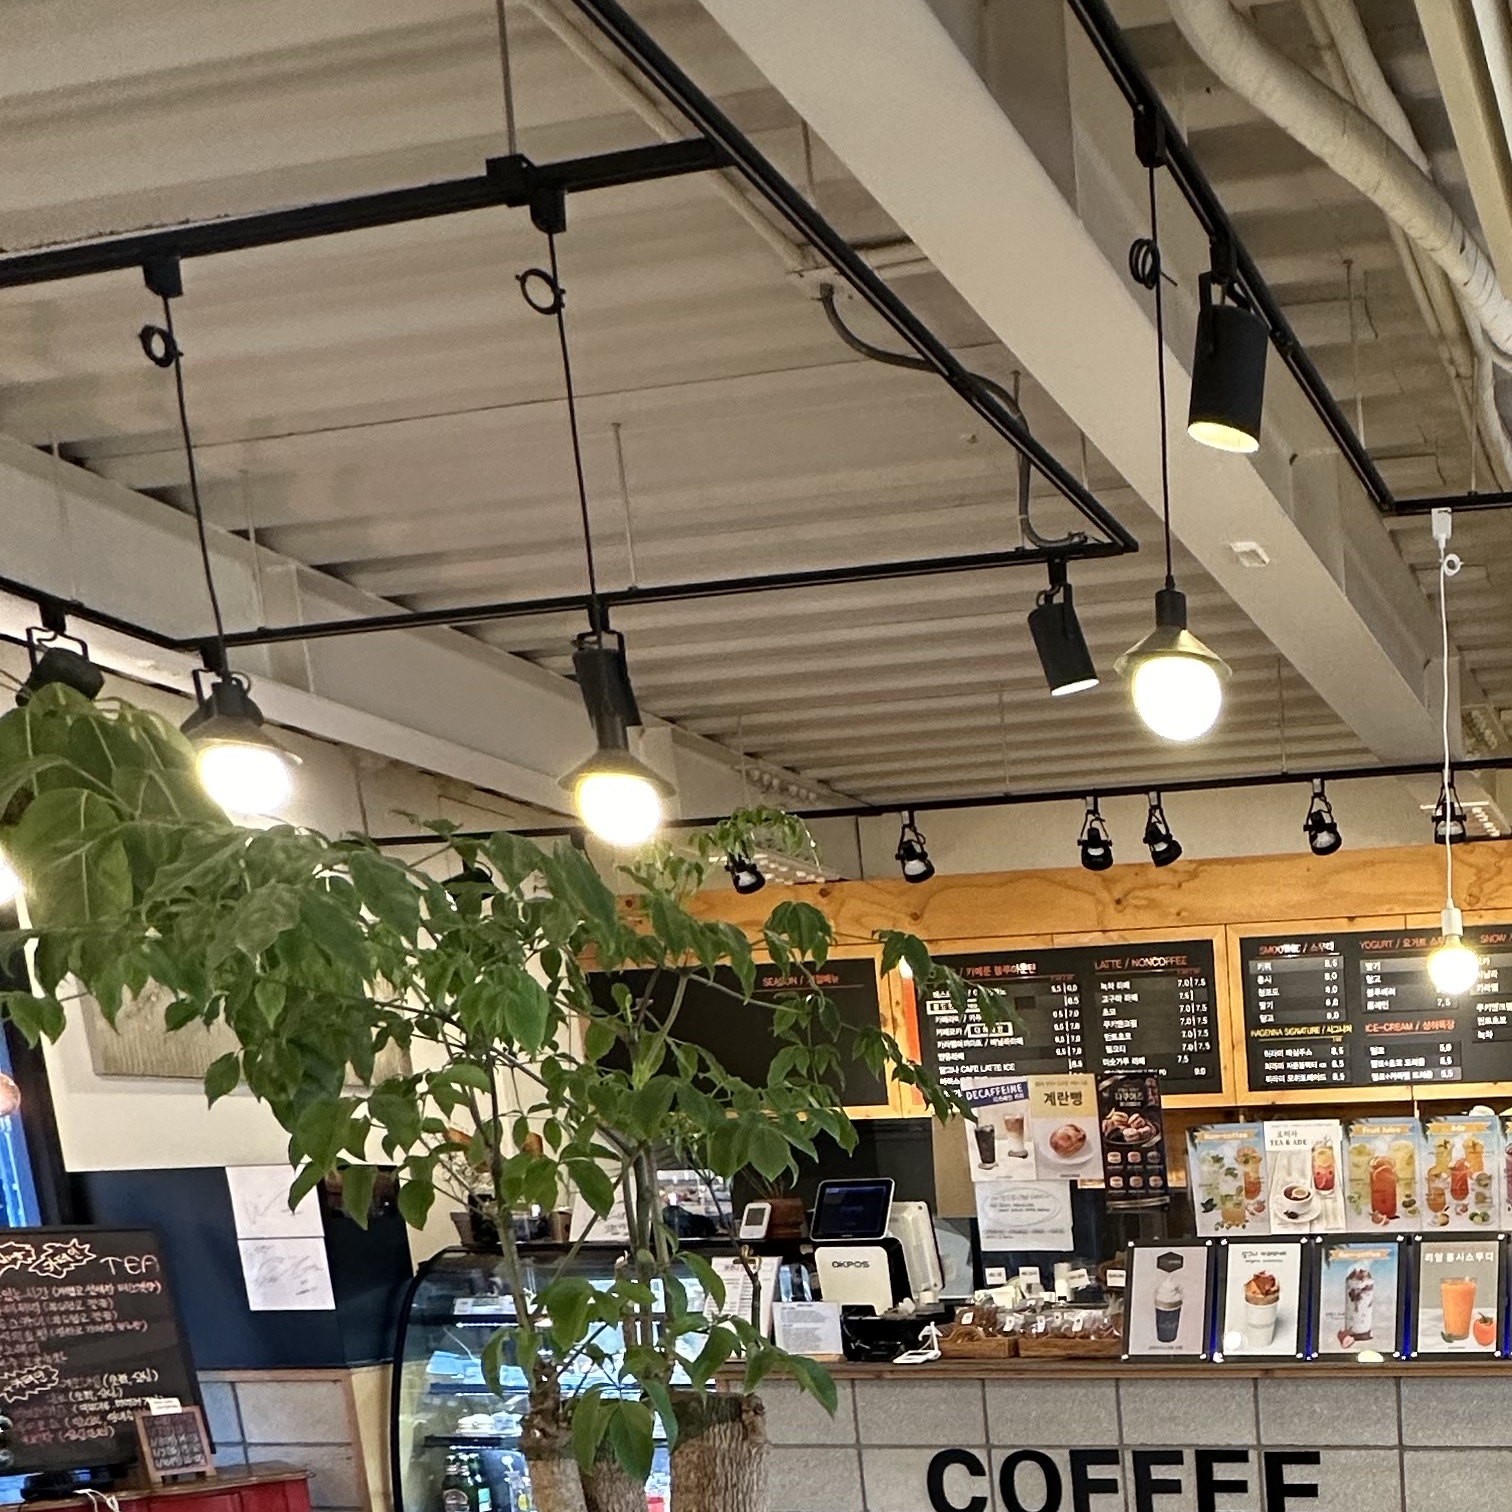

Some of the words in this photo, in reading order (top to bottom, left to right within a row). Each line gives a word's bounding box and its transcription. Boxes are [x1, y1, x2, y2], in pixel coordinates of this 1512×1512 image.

[1360, 940, 1393, 950] YOGURT
[1094, 959, 1122, 969] LATTE
[1365, 1023, 1413, 1032] ICE-CREAM
[966, 1084, 1023, 1100] DECAFFEINE
[1044, 1091, 1082, 1106] 계란빵
[100, 1255, 159, 1275] TEA
[831, 1260, 870, 1269] OKPOS
